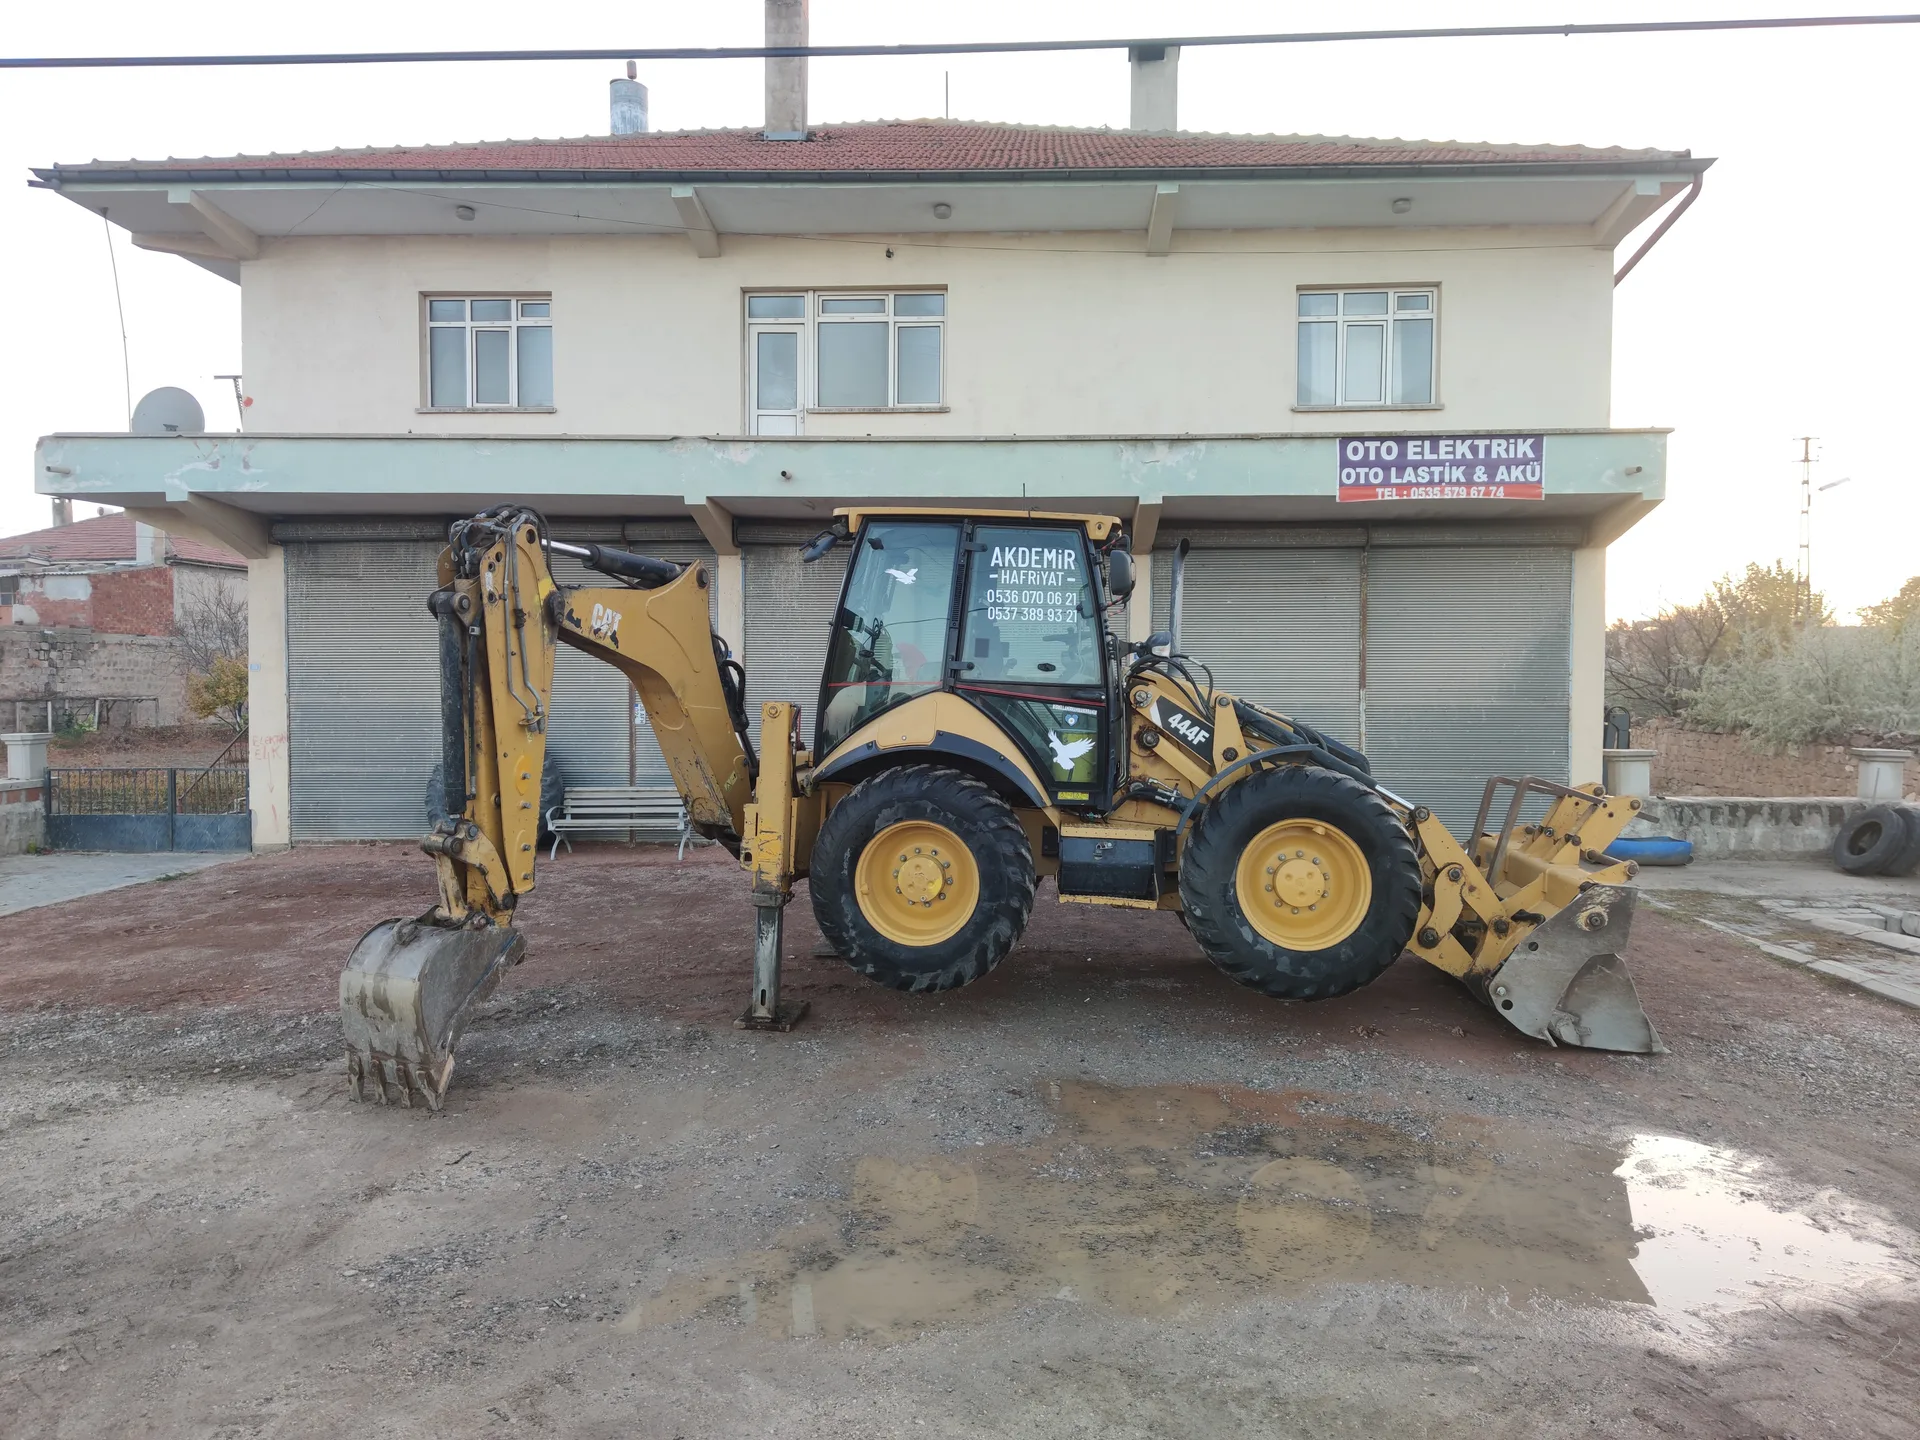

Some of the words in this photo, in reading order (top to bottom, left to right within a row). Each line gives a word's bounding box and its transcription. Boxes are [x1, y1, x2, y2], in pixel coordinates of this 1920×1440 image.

[1346, 441, 1398, 461] OTO
[1341, 467, 1384, 484] OTO
[1390, 462, 1466, 483] LASTİK
[1473, 465, 1488, 482] &
[1495, 461, 1541, 482] AKÜ
[1410, 487, 1440, 499] 0535
[1444, 487, 1467, 498] 579
[1470, 487, 1485, 498] 67
[1490, 486, 1504, 498] 74
[987, 589, 1018, 603] 0536
[1022, 590, 1043, 604] 070
[1047, 591, 1062, 605] 06
[1065, 593, 1076, 606] 21
[592, 603, 622, 635] CAT
[987, 606, 1018, 620] 0537
[1021, 607, 1044, 621] 389
[1047, 608, 1062, 622] 93
[1066, 609, 1077, 623] 21
[1168, 713, 1210, 745] 444F
